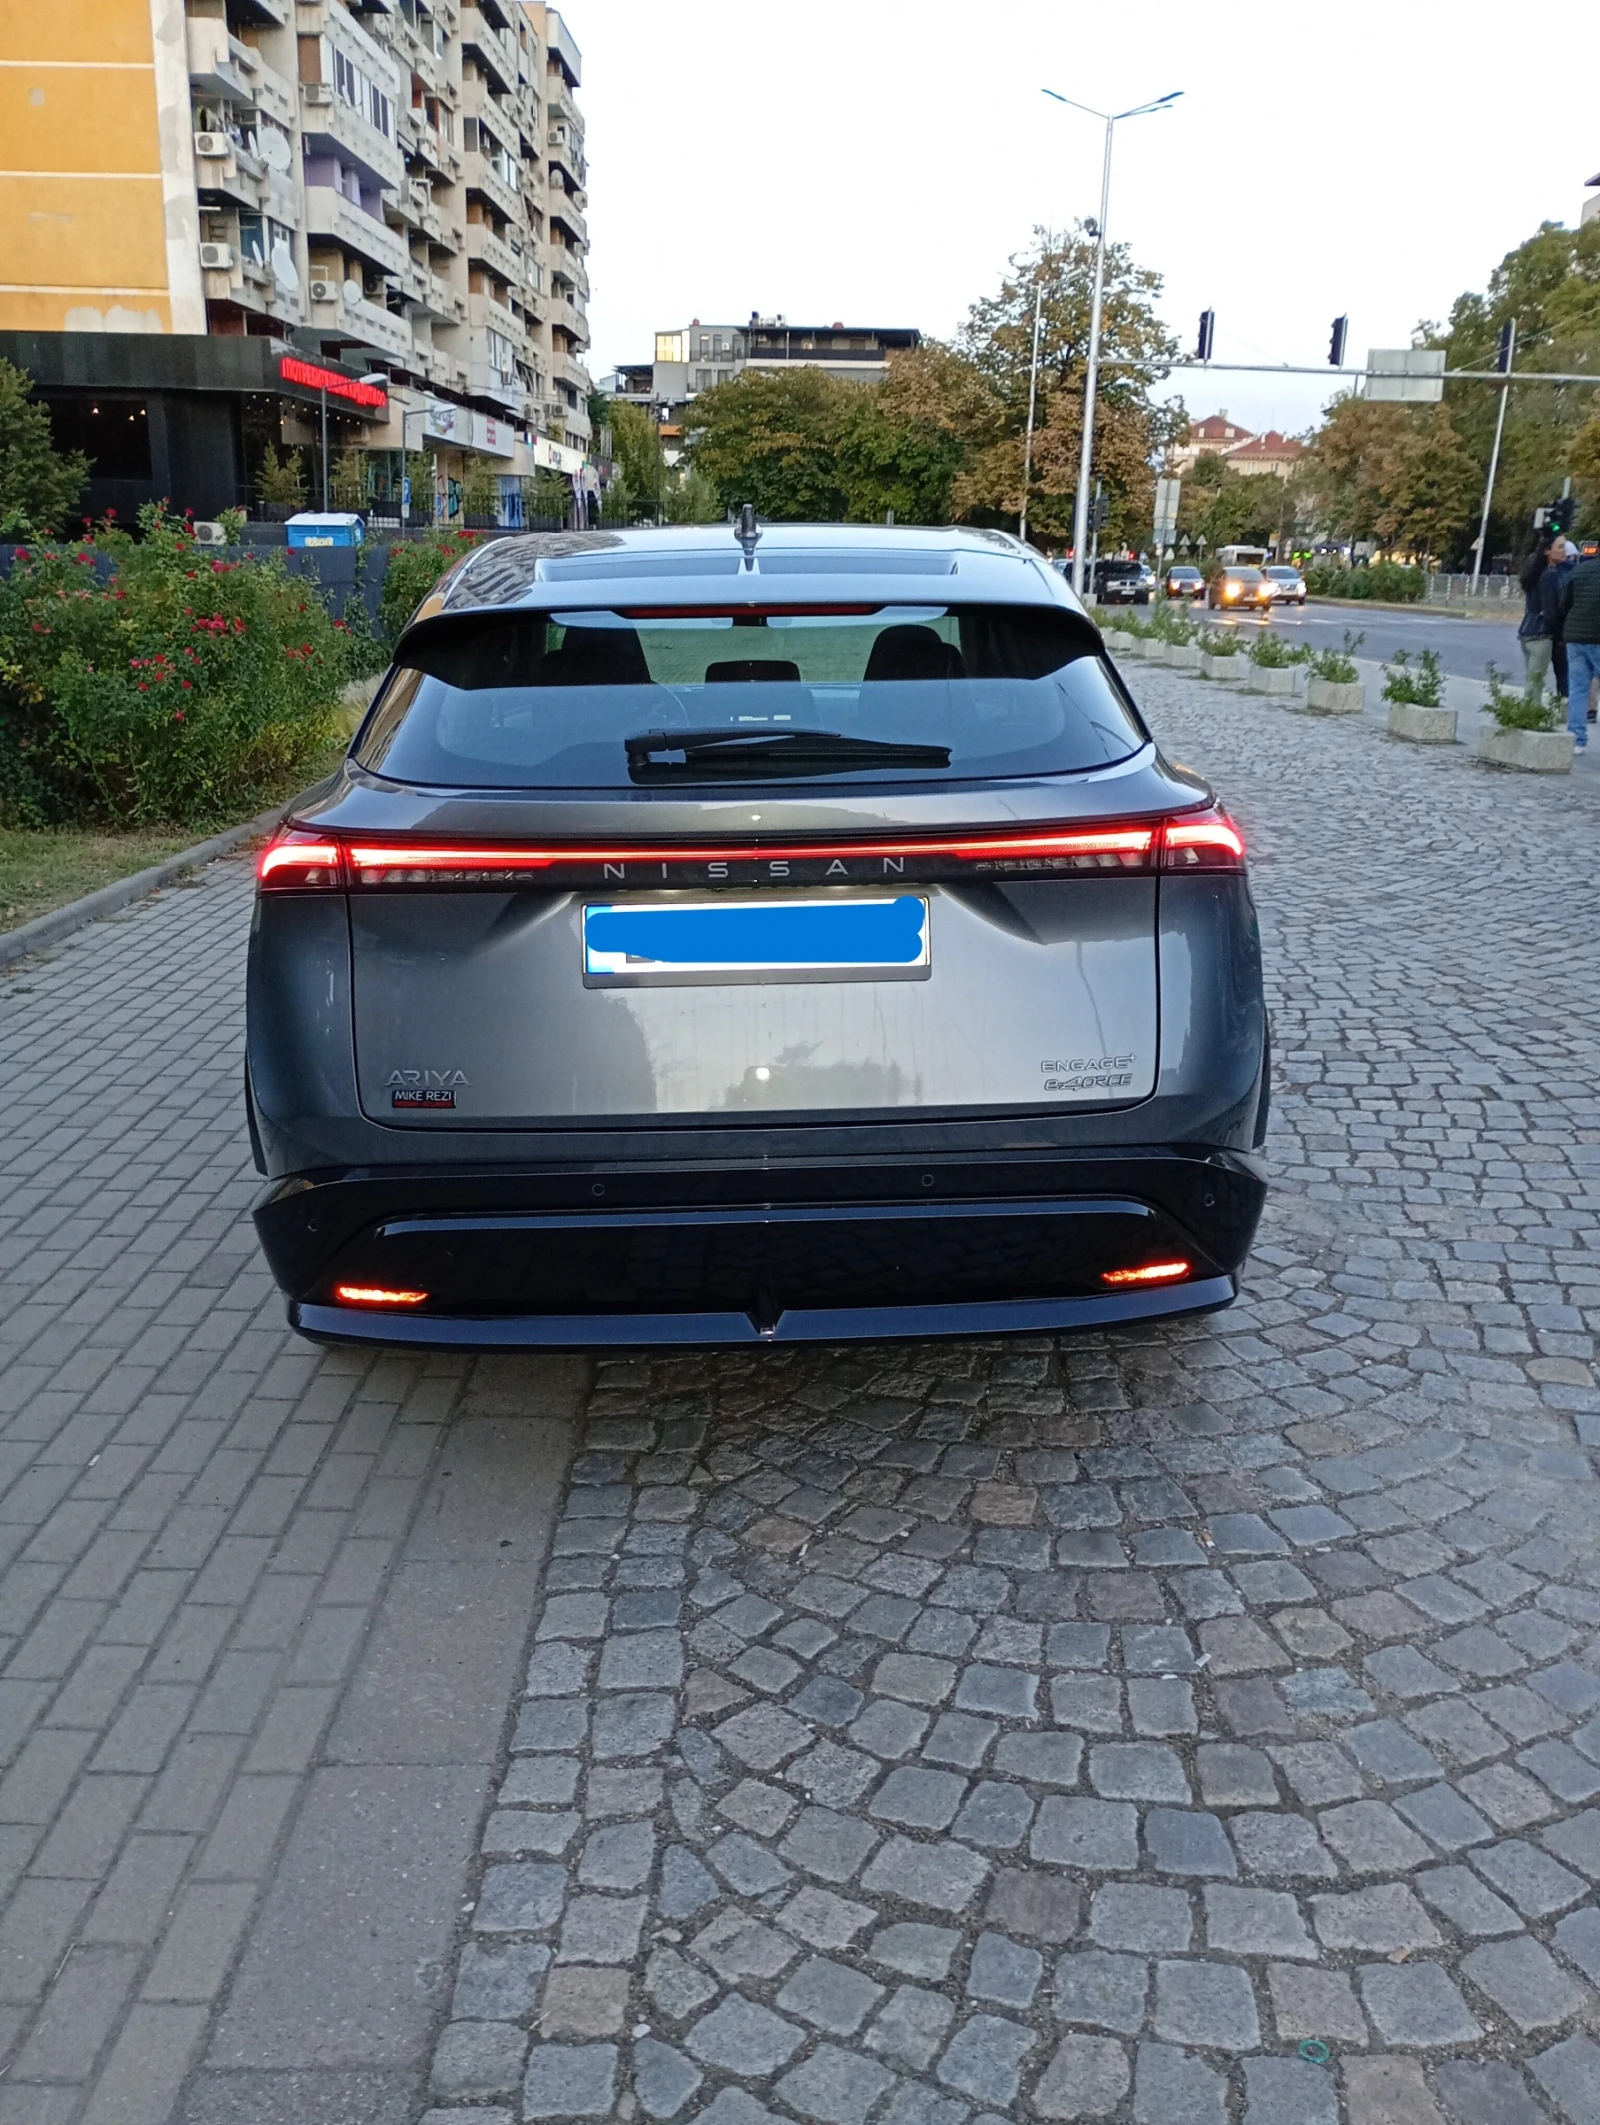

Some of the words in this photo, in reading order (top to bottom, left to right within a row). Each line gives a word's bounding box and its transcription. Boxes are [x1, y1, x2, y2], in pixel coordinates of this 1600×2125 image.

[603, 856, 905, 880] NISSAN
[384, 1069, 473, 1087] ARIYA
[394, 1090, 423, 1101] MIKE
[426, 1090, 452, 1101] REZI
